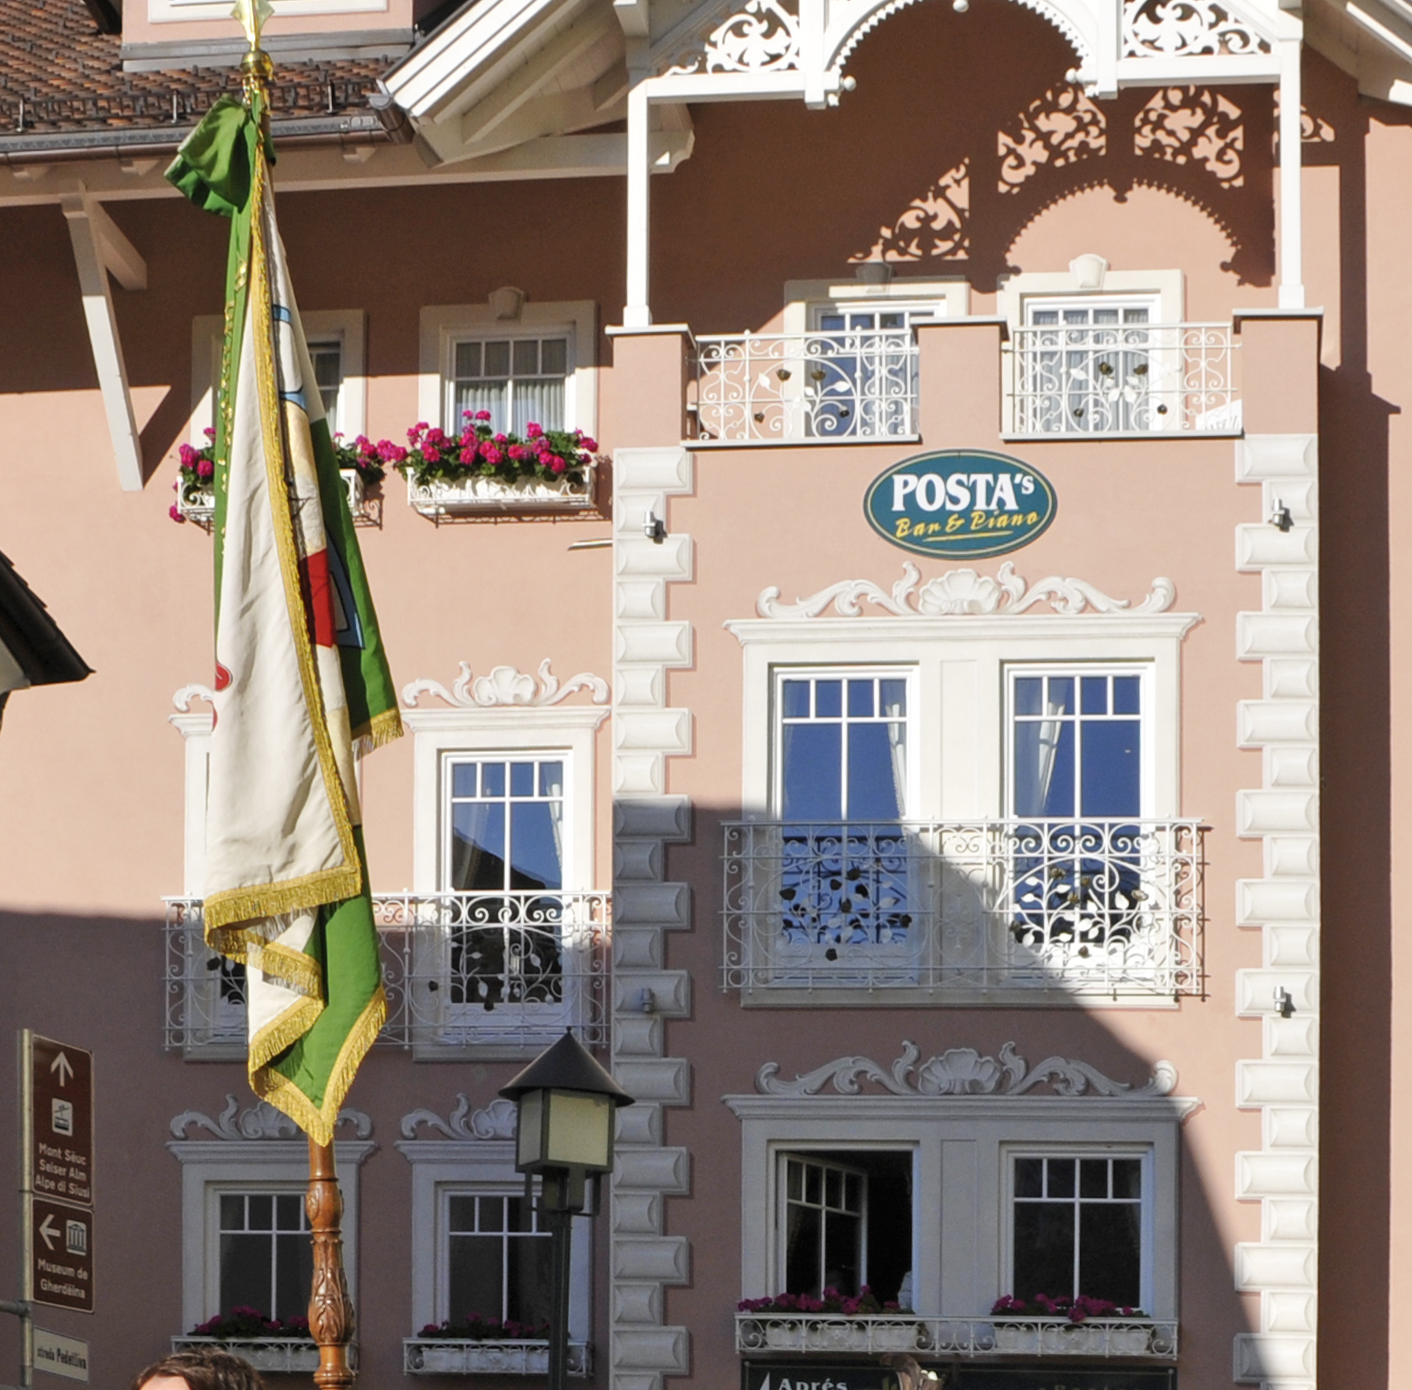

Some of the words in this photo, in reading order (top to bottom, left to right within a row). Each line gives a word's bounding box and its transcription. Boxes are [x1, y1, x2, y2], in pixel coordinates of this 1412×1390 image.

[891, 473, 1035, 512] POSTA's
[894, 517, 941, 539] Bar
[945, 512, 965, 533] &
[970, 509, 1041, 530] Piano
[38, 1142, 62, 1160] Mont
[39, 1158, 67, 1176] Seiser
[69, 1167, 87, 1182] Alm
[35, 1174, 56, 1190] Alpe
[57, 1180, 67, 1192] di
[68, 1182, 90, 1198] Siusi
[37, 1258, 75, 1277] Museum
[77, 1267, 88, 1280] de
